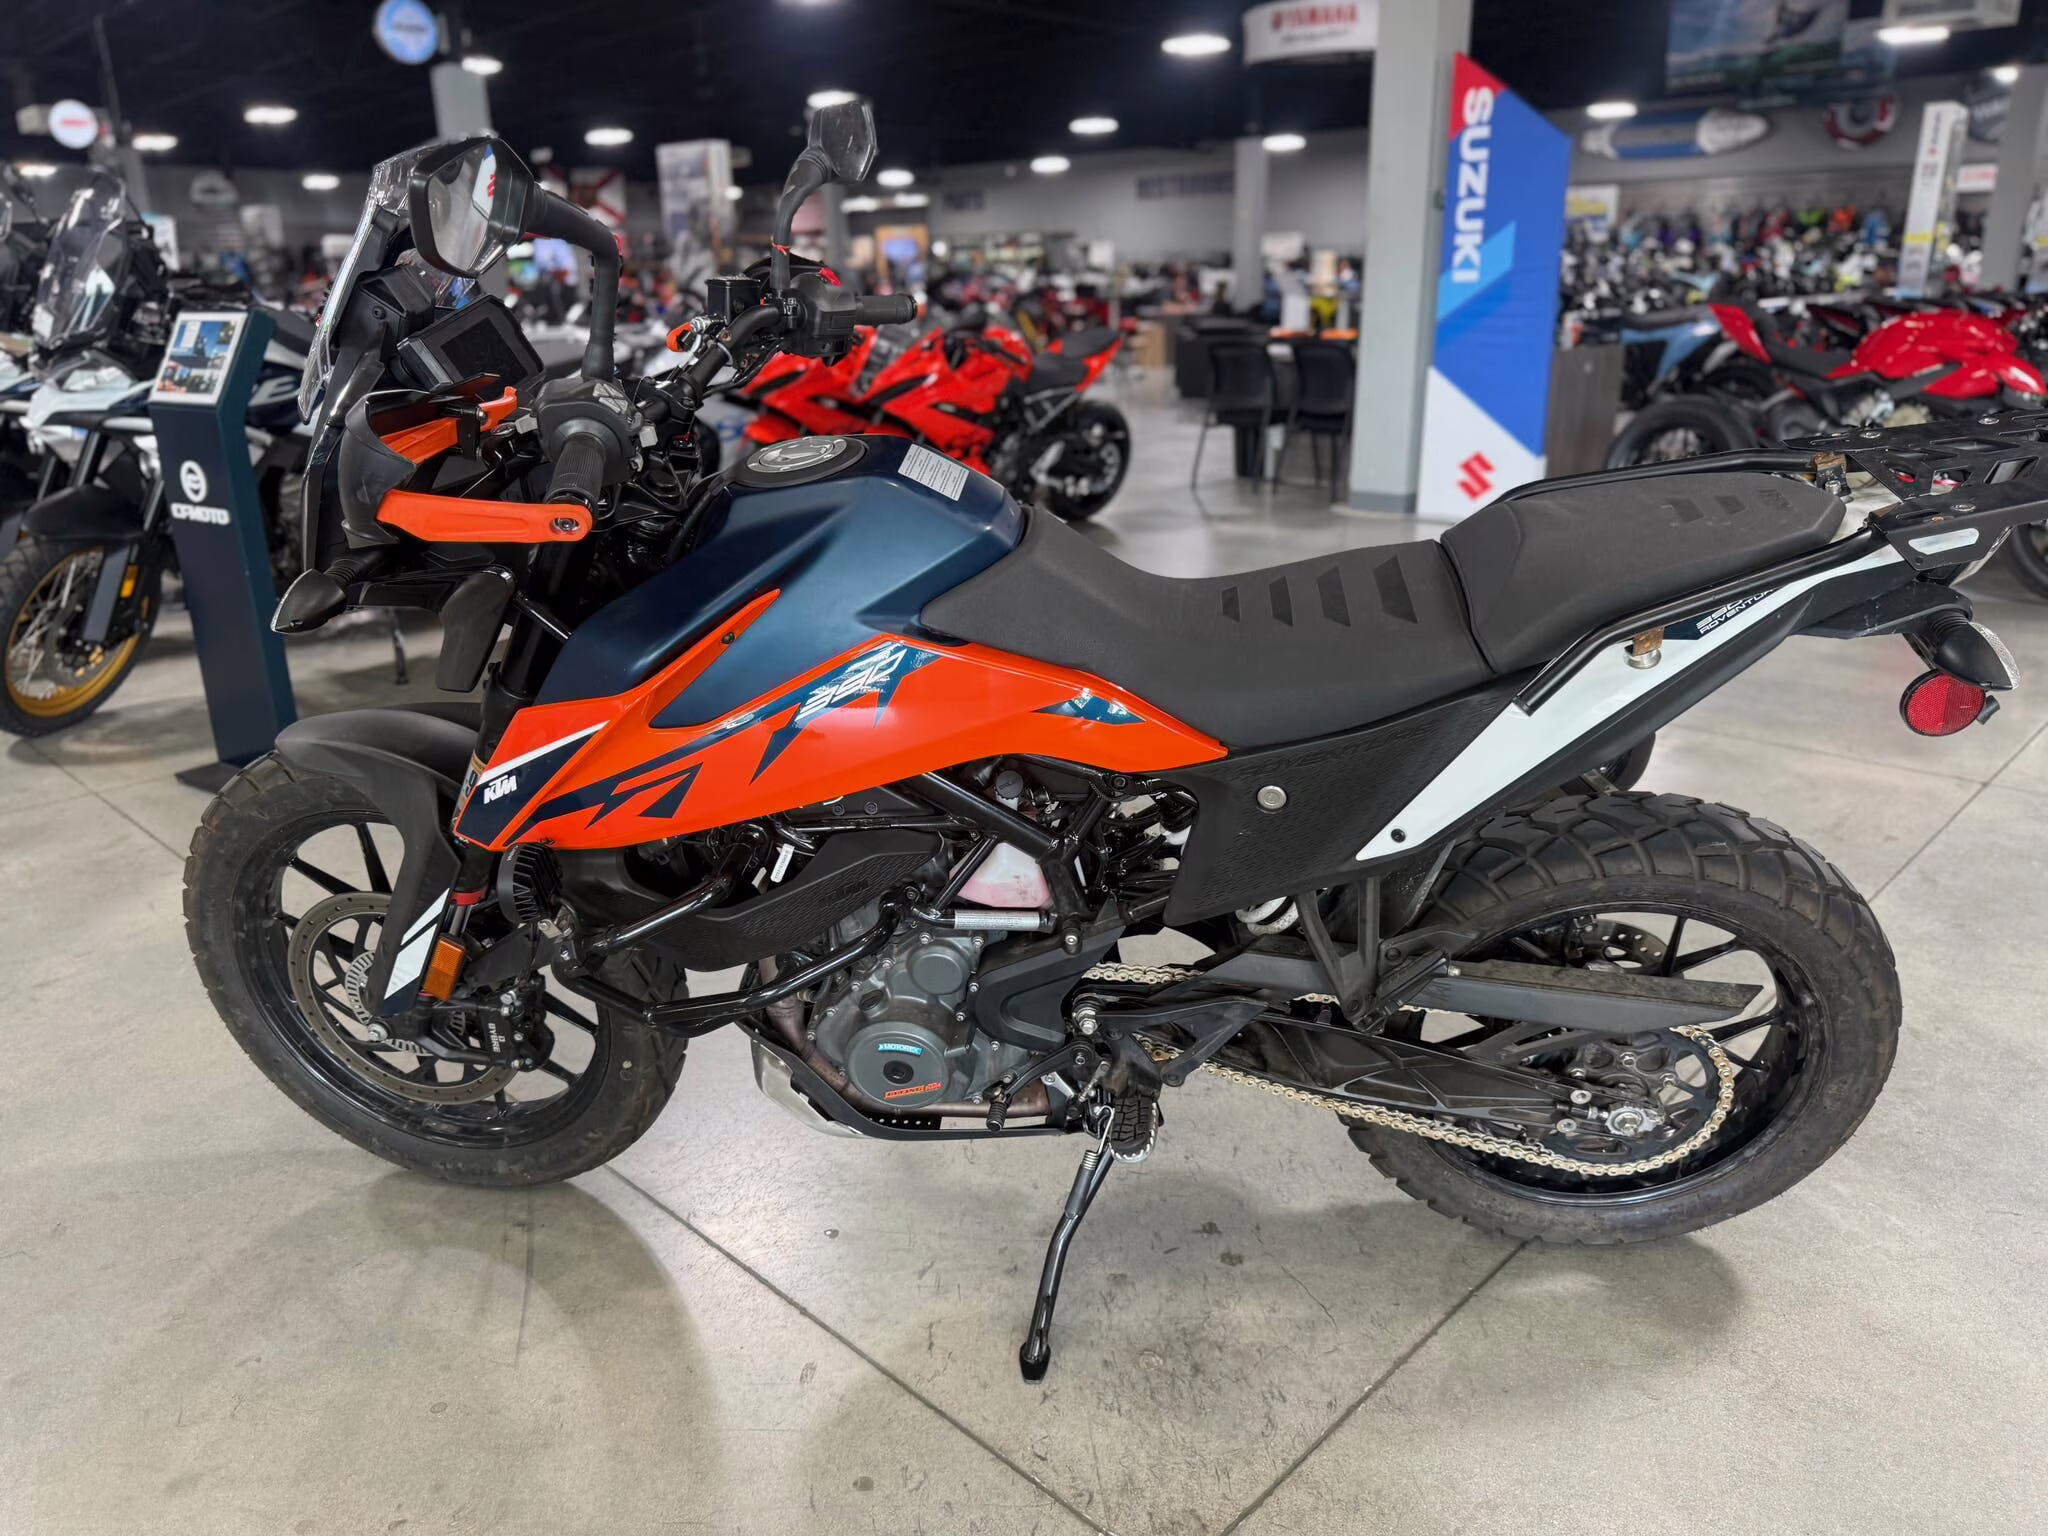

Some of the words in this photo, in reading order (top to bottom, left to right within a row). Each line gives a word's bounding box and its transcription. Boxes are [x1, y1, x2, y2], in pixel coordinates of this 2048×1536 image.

[1452, 86, 1494, 284] SUZUKI
[170, 502, 231, 525] CFMOTO
[1699, 588, 1775, 634] ADVENTUR
[483, 774, 517, 804] KTM
[488, 1022, 500, 1053] BYBRE
